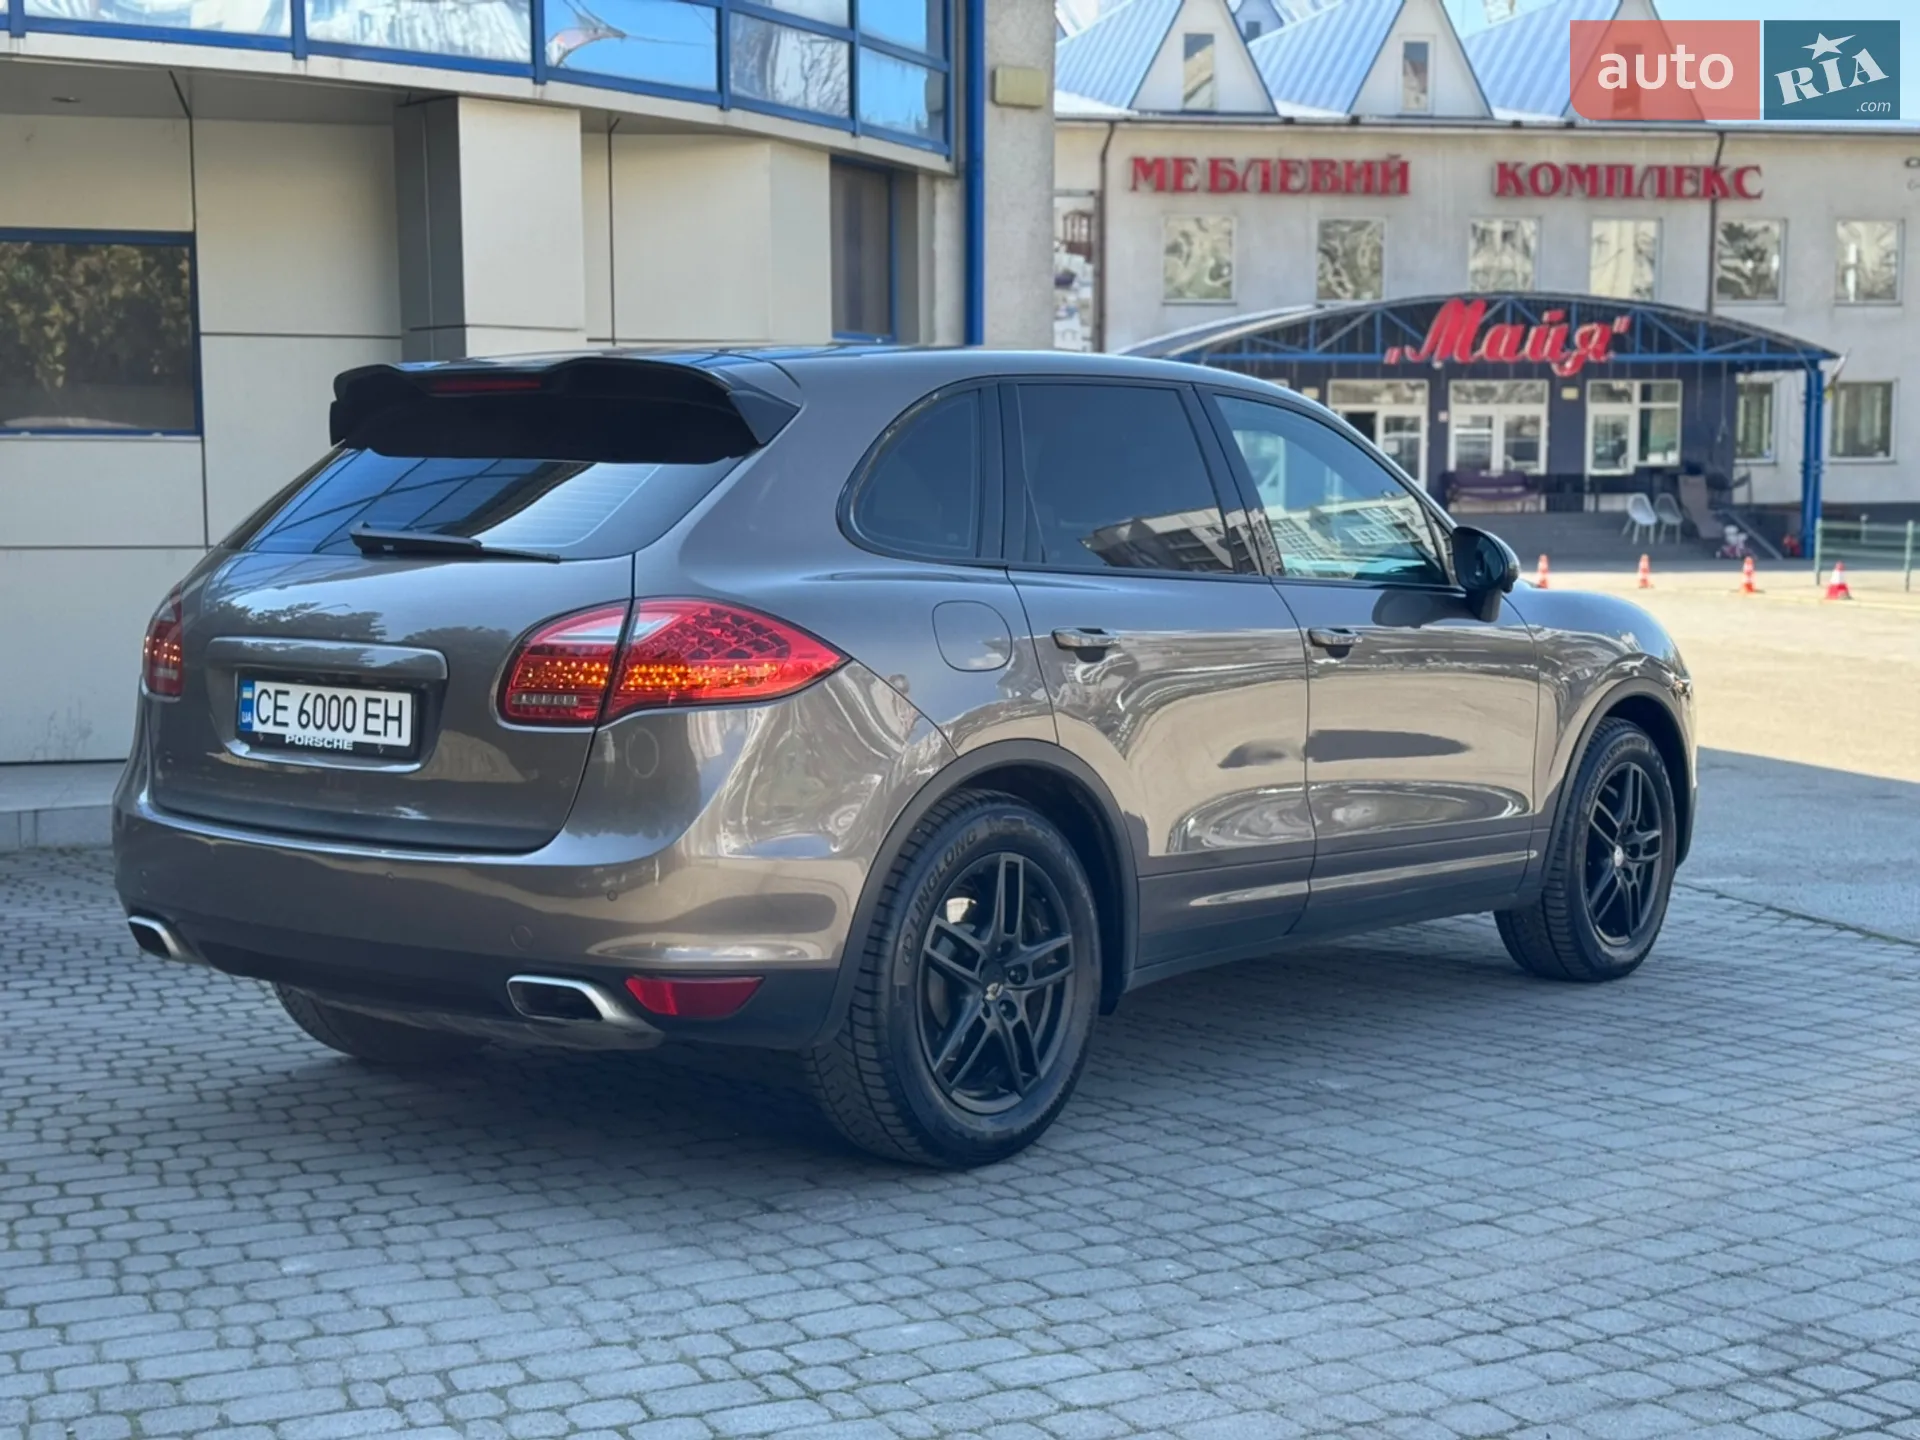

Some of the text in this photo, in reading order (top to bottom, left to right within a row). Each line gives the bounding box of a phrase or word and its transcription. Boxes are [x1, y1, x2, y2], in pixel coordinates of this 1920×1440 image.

[1130, 153, 1764, 200] МЕБЛЕВИЙ КОМПЛЕКС
[241, 711, 253, 724] UA
[256, 688, 402, 739] CE 6000 EH
[285, 734, 353, 751] PORSCHE
[909, 828, 978, 930] LINGLONG
